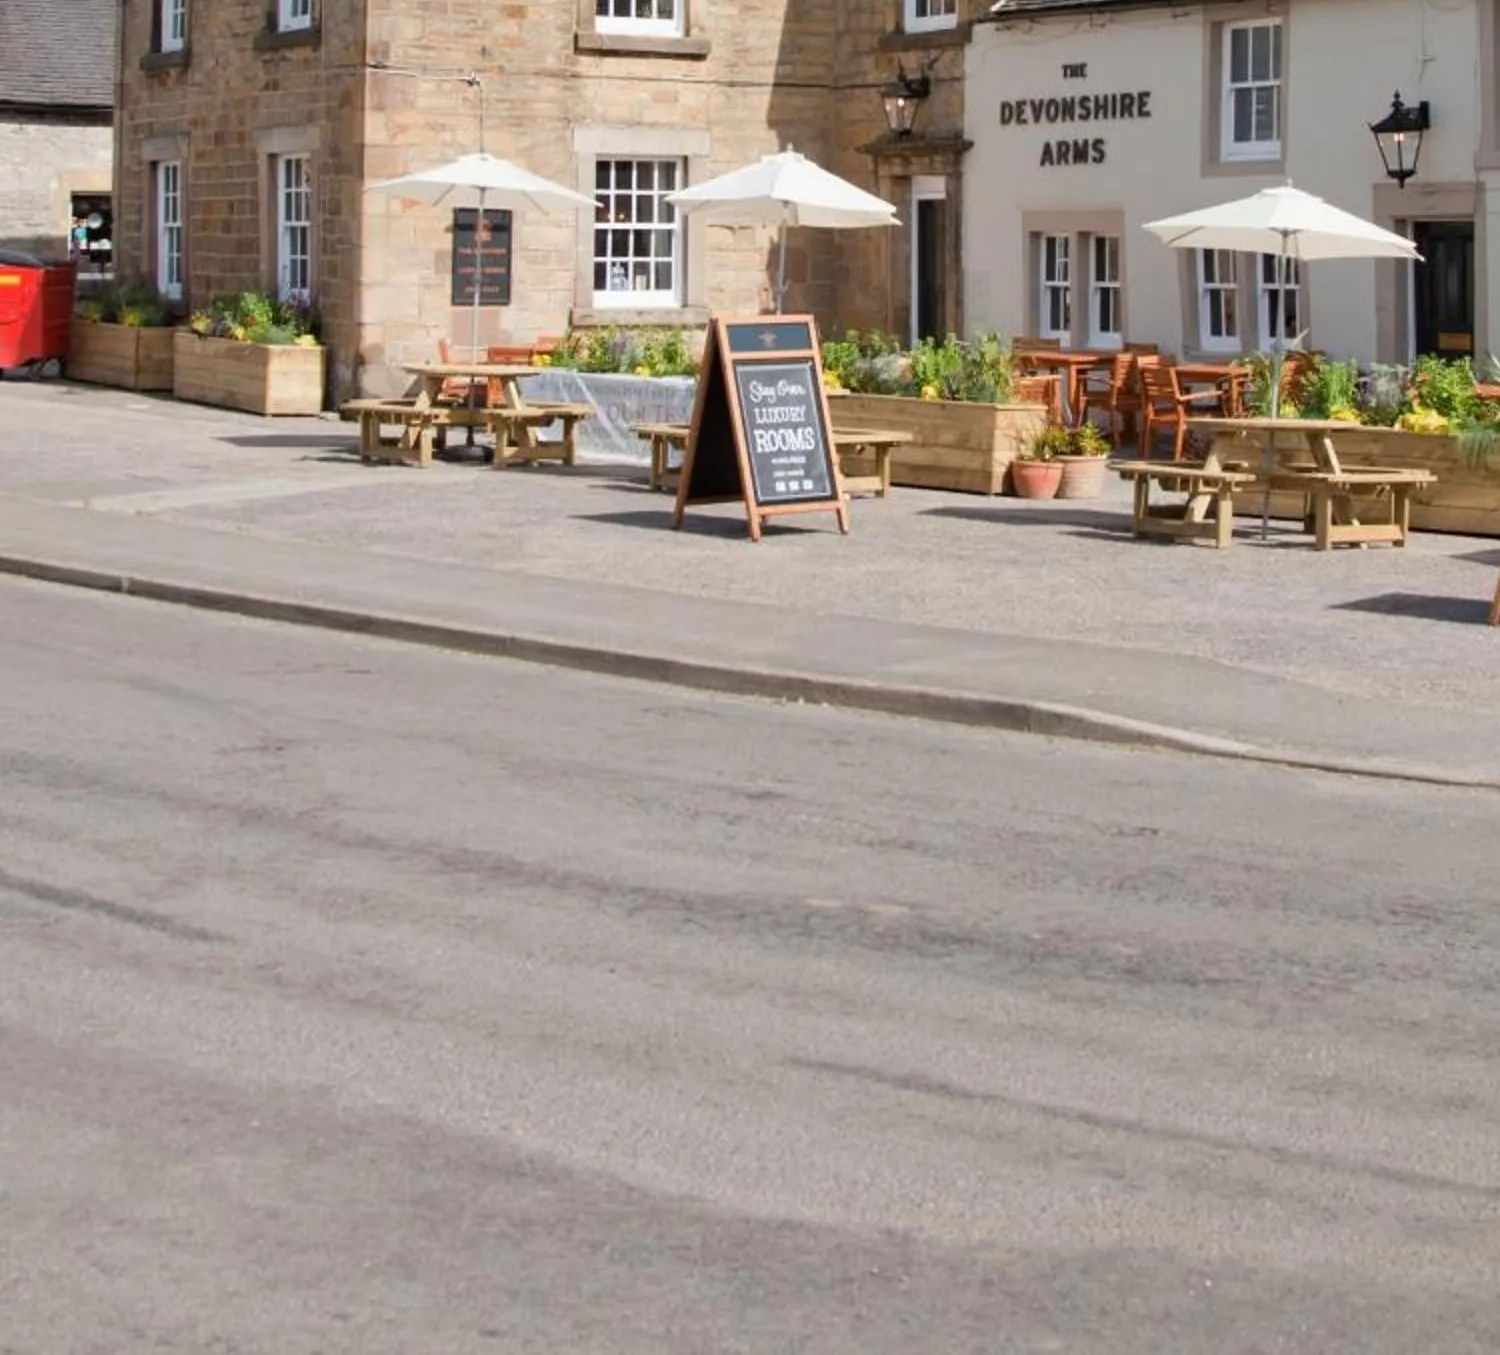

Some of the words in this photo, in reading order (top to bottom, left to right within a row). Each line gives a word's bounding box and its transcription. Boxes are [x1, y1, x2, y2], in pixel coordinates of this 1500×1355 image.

[1062, 63, 1088, 79] THE
[1000, 91, 1153, 126] DEVONSHIRE
[1040, 138, 1106, 167] ARMS
[754, 405, 807, 424] LUXURY
[753, 426, 815, 453] ROOMS
